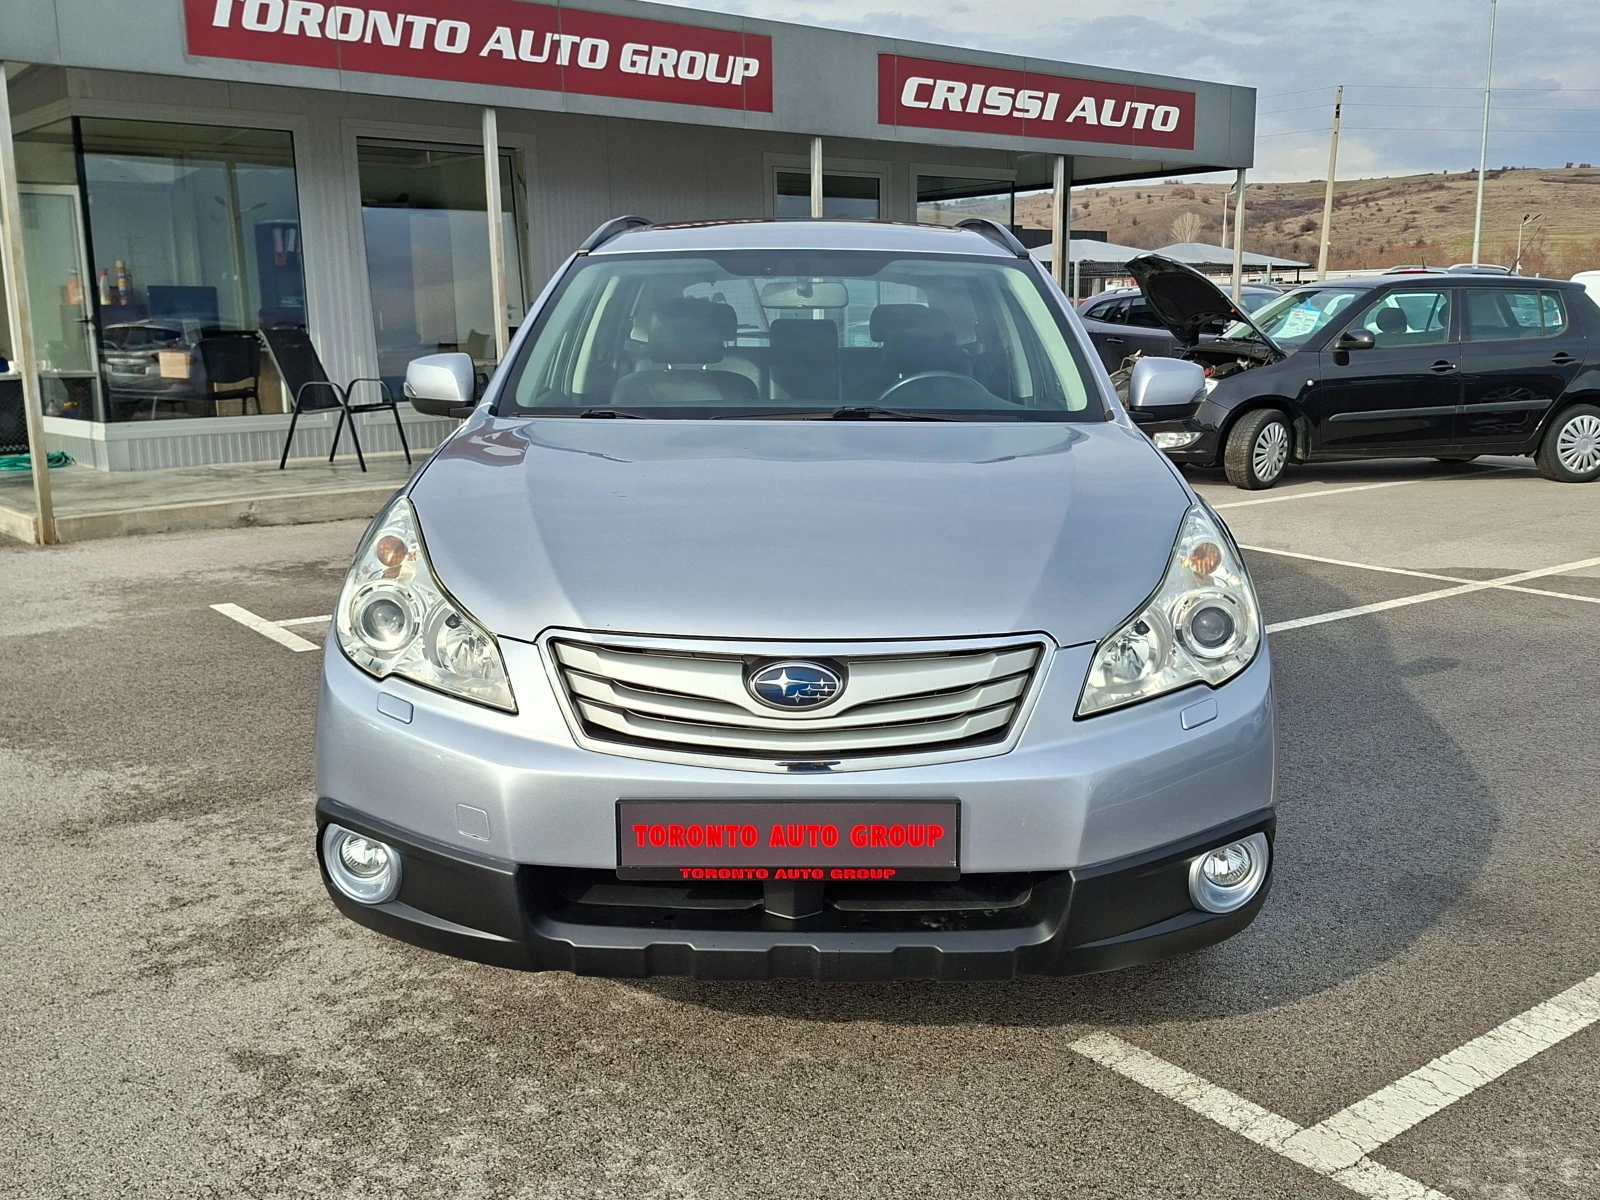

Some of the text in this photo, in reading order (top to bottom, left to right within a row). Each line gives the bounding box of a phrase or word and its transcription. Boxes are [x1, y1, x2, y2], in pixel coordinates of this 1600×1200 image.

[479, 26, 610, 70] AUTO
[619, 43, 760, 86] GROUP
[900, 76, 1180, 132] CRISSI AUTO
